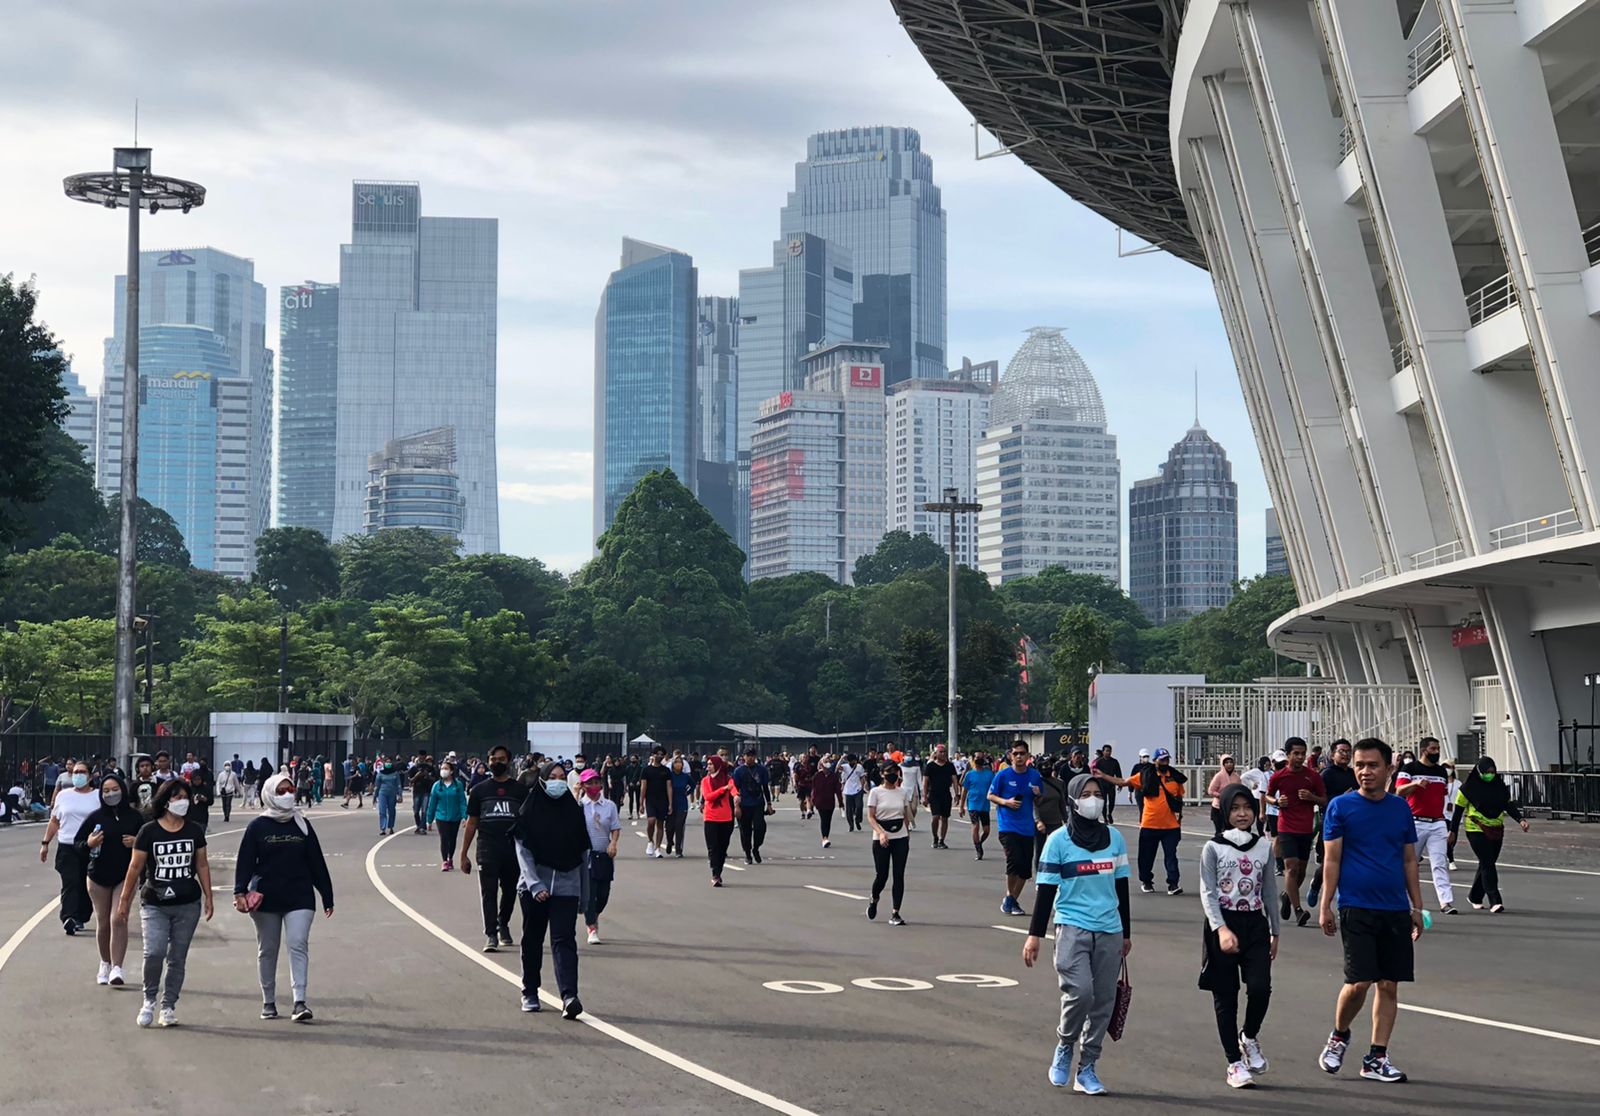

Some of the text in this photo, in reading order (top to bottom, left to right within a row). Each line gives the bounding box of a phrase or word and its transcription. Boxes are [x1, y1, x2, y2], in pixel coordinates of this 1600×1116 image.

[157, 842, 192, 855] OPEN
[159, 855, 190, 865] YOUR
[1080, 863, 1111, 871] KAZOKU
